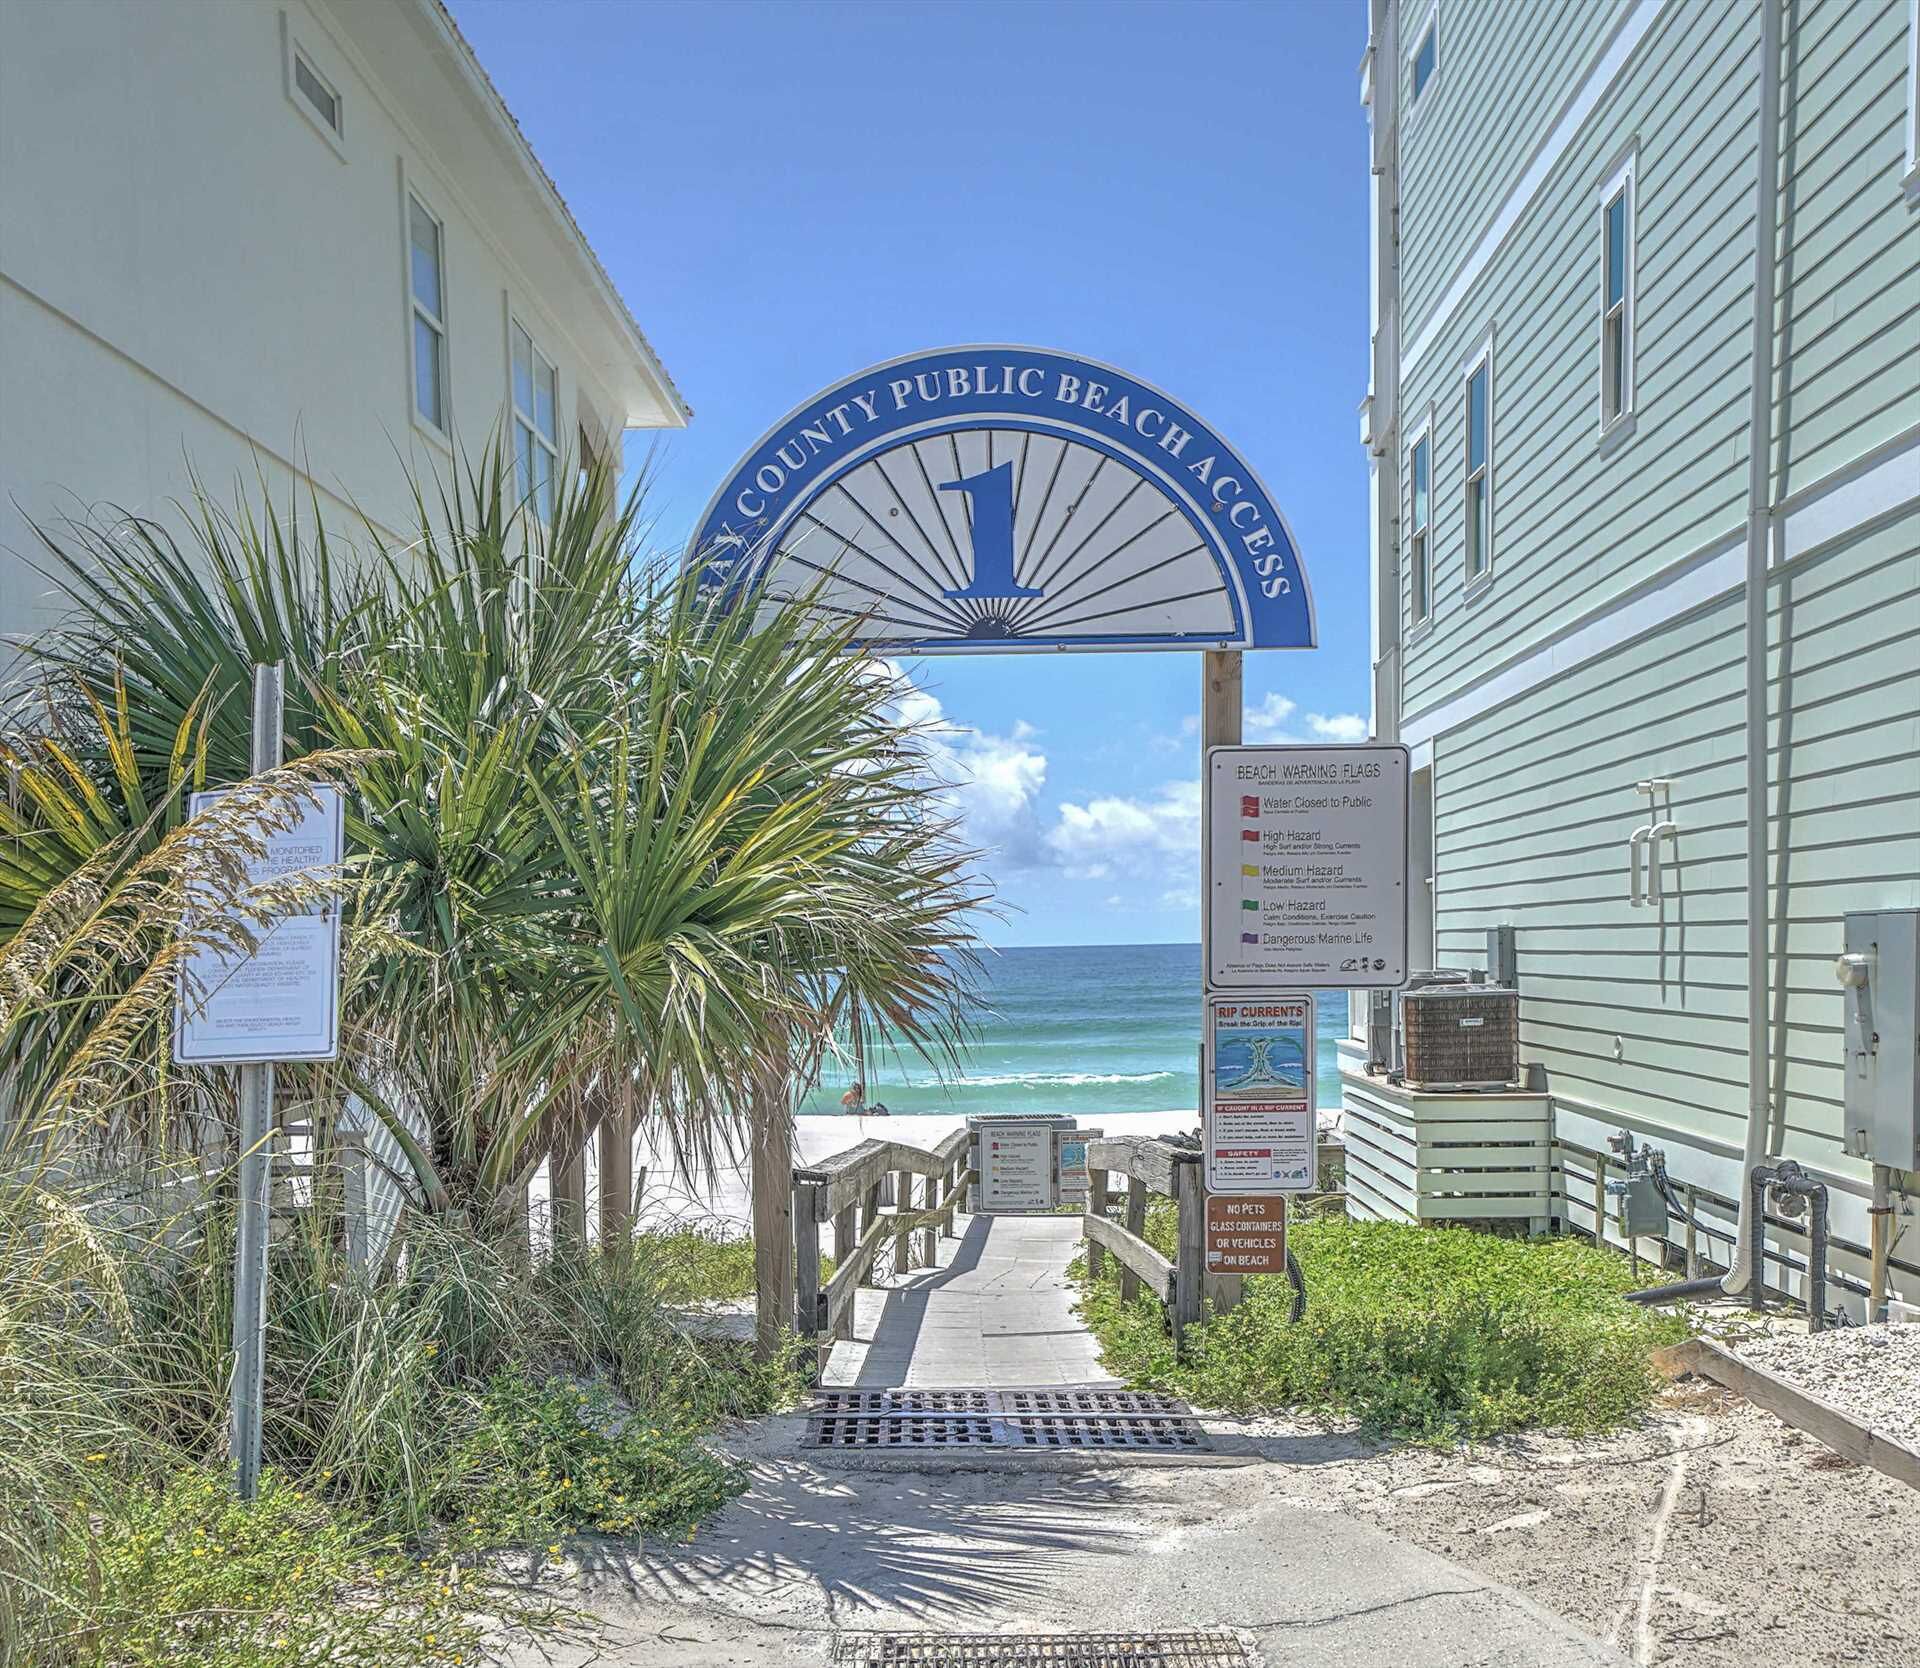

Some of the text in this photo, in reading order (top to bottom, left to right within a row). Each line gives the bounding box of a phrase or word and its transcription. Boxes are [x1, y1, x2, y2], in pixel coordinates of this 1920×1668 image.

[735, 389, 881, 519] COUNTY
[889, 365, 1045, 412] PUBLIC
[1053, 374, 1194, 460] BEACH
[1187, 453, 1292, 601] ACCESS
[939, 460, 1044, 599] 1
[1237, 763, 1381, 779] BEACH WARNING FLAGS
[1263, 795, 1372, 808] Water Closed to Public
[1263, 829, 1321, 842] High Hazard
[270, 846, 323, 856] MONITORED
[281, 855, 321, 865] HEALTHY
[262, 865, 309, 876] PROGRA
[1263, 864, 1344, 876] Medium Hazard
[1263, 899, 1326, 911] Low Hazard
[1263, 931, 1373, 946] Dangerous Marine Life
[1219, 1006, 1303, 1018] RIP CURRENTS
[1226, 1203, 1265, 1215] NO PETS
[1210, 1221, 1282, 1232] GLASS CONTAINERS
[1216, 1238, 1277, 1249] OR VEHICLES
[1223, 1255, 1270, 1266] ON BEACH
